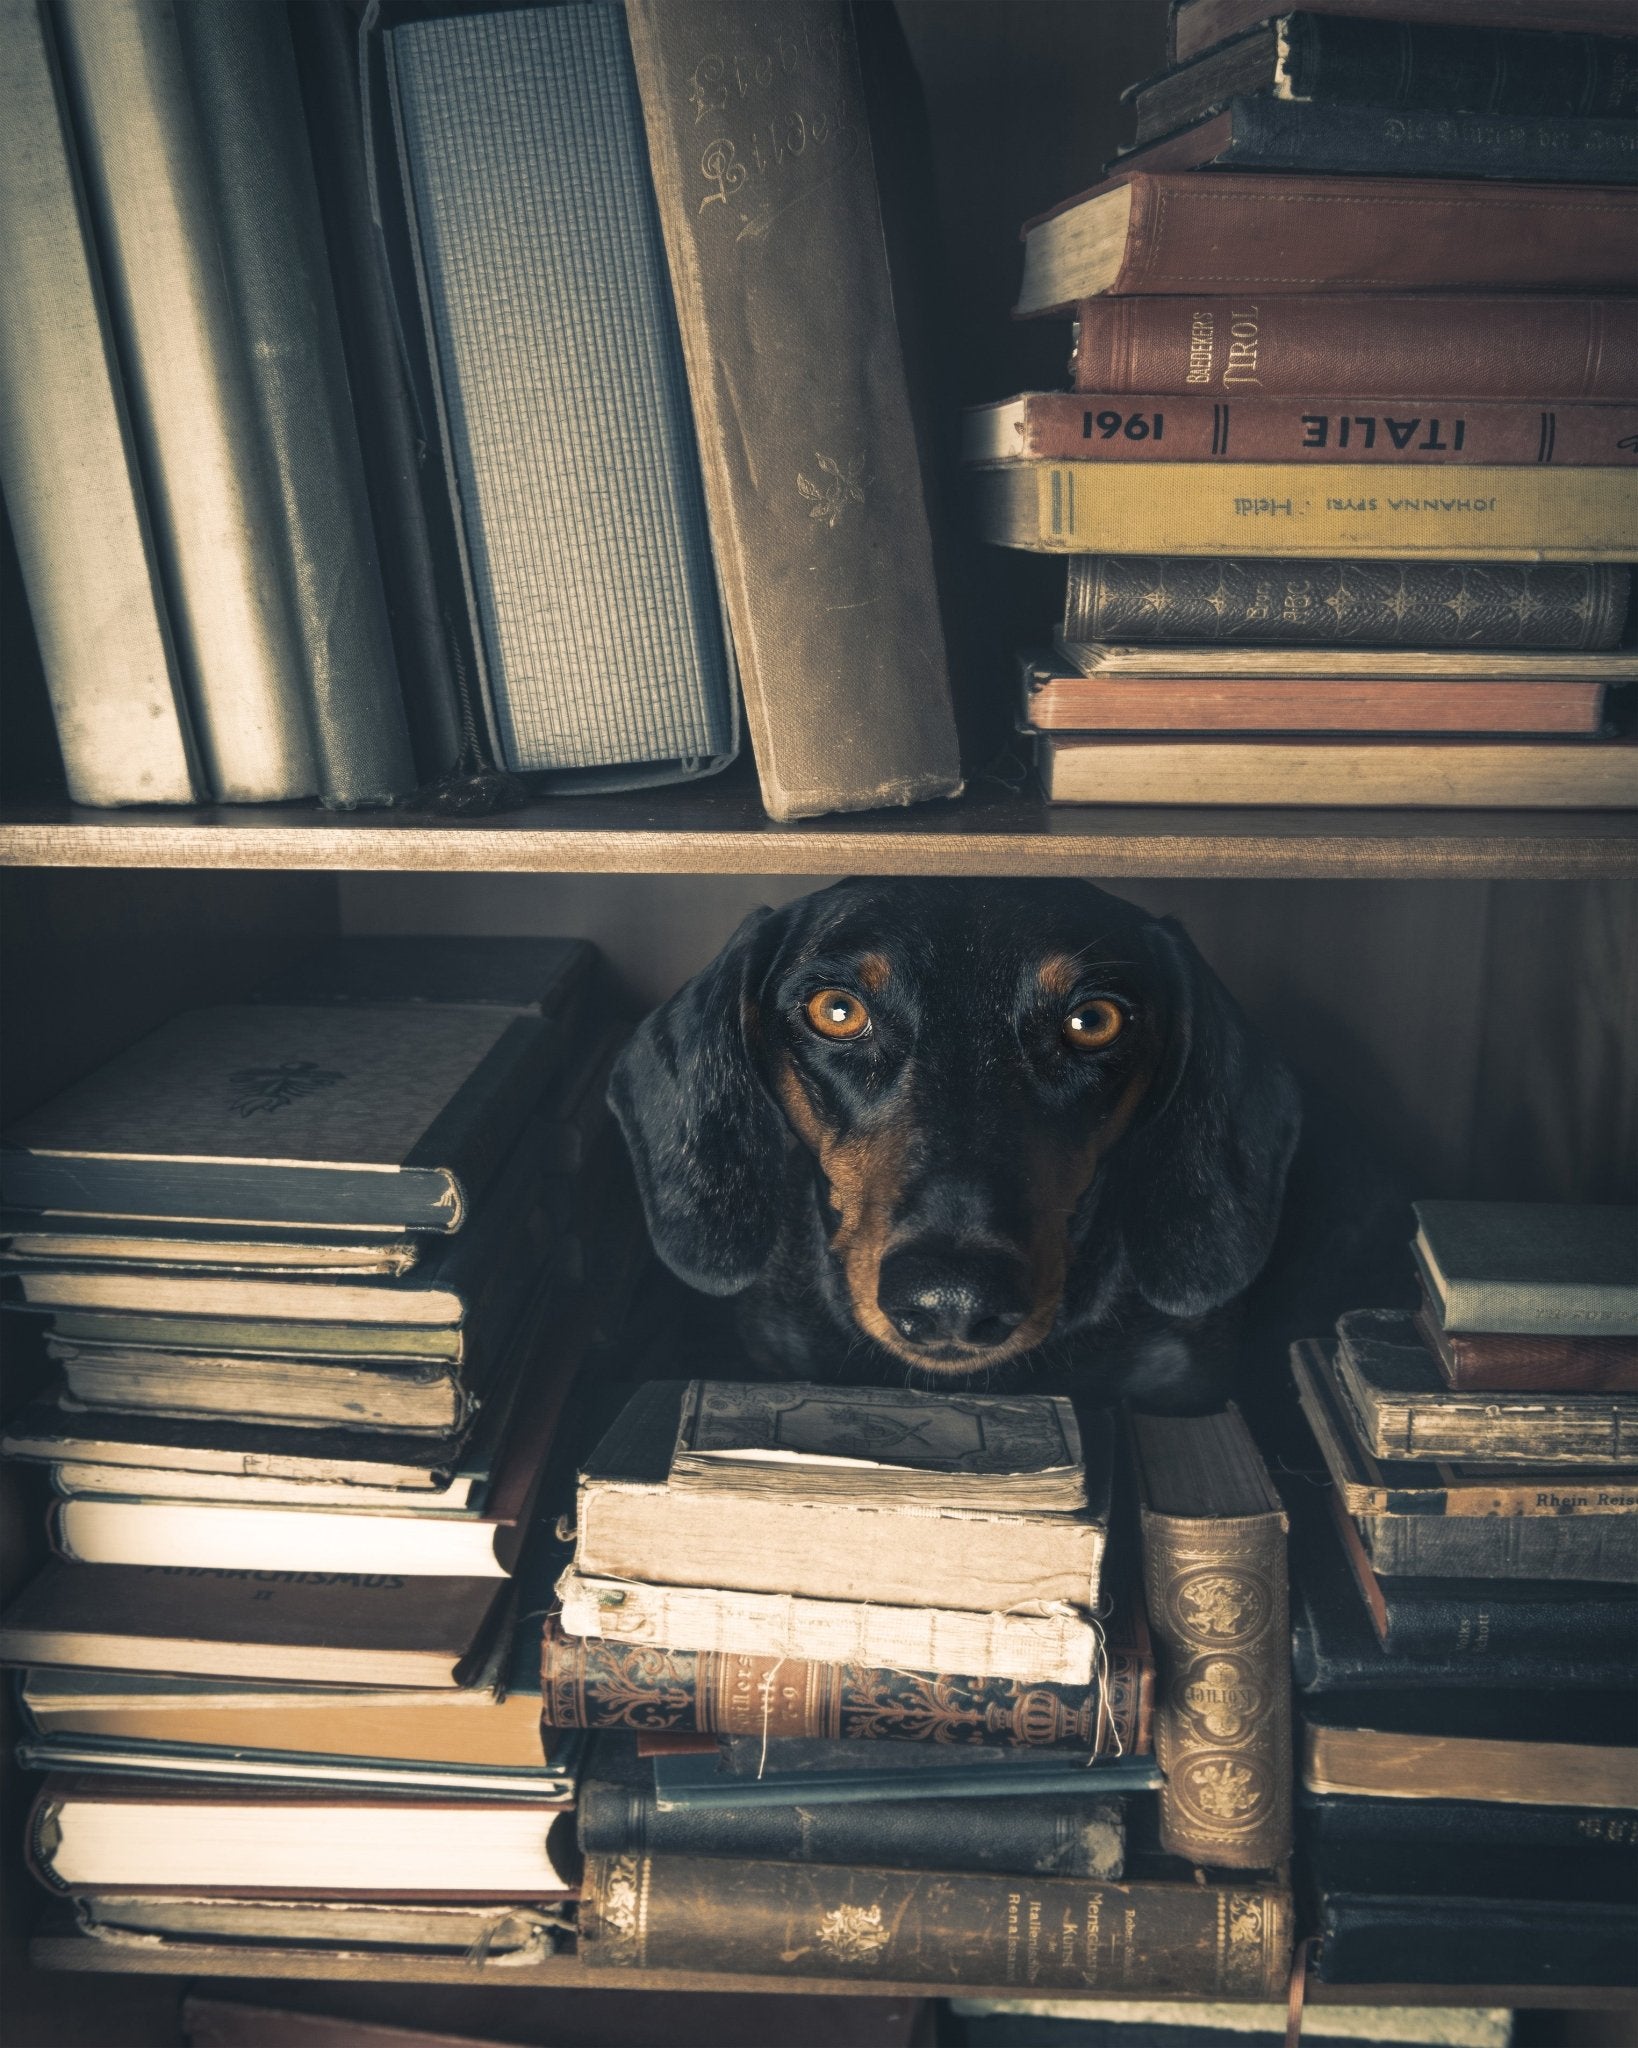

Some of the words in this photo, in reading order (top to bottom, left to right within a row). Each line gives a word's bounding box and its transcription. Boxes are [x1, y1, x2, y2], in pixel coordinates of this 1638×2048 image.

[1222, 305, 1264, 390] TIROL
[1082, 409, 1165, 442] 1961
[1301, 414, 1465, 451] ITALIE
[1233, 498, 1292, 517] Heidi
[1326, 498, 1378, 511] SPYRI
[1387, 497, 1496, 512] JOHANNA
[1536, 1492, 1589, 1507] Rhein
[1062, 1922, 1078, 1968] Kunst
